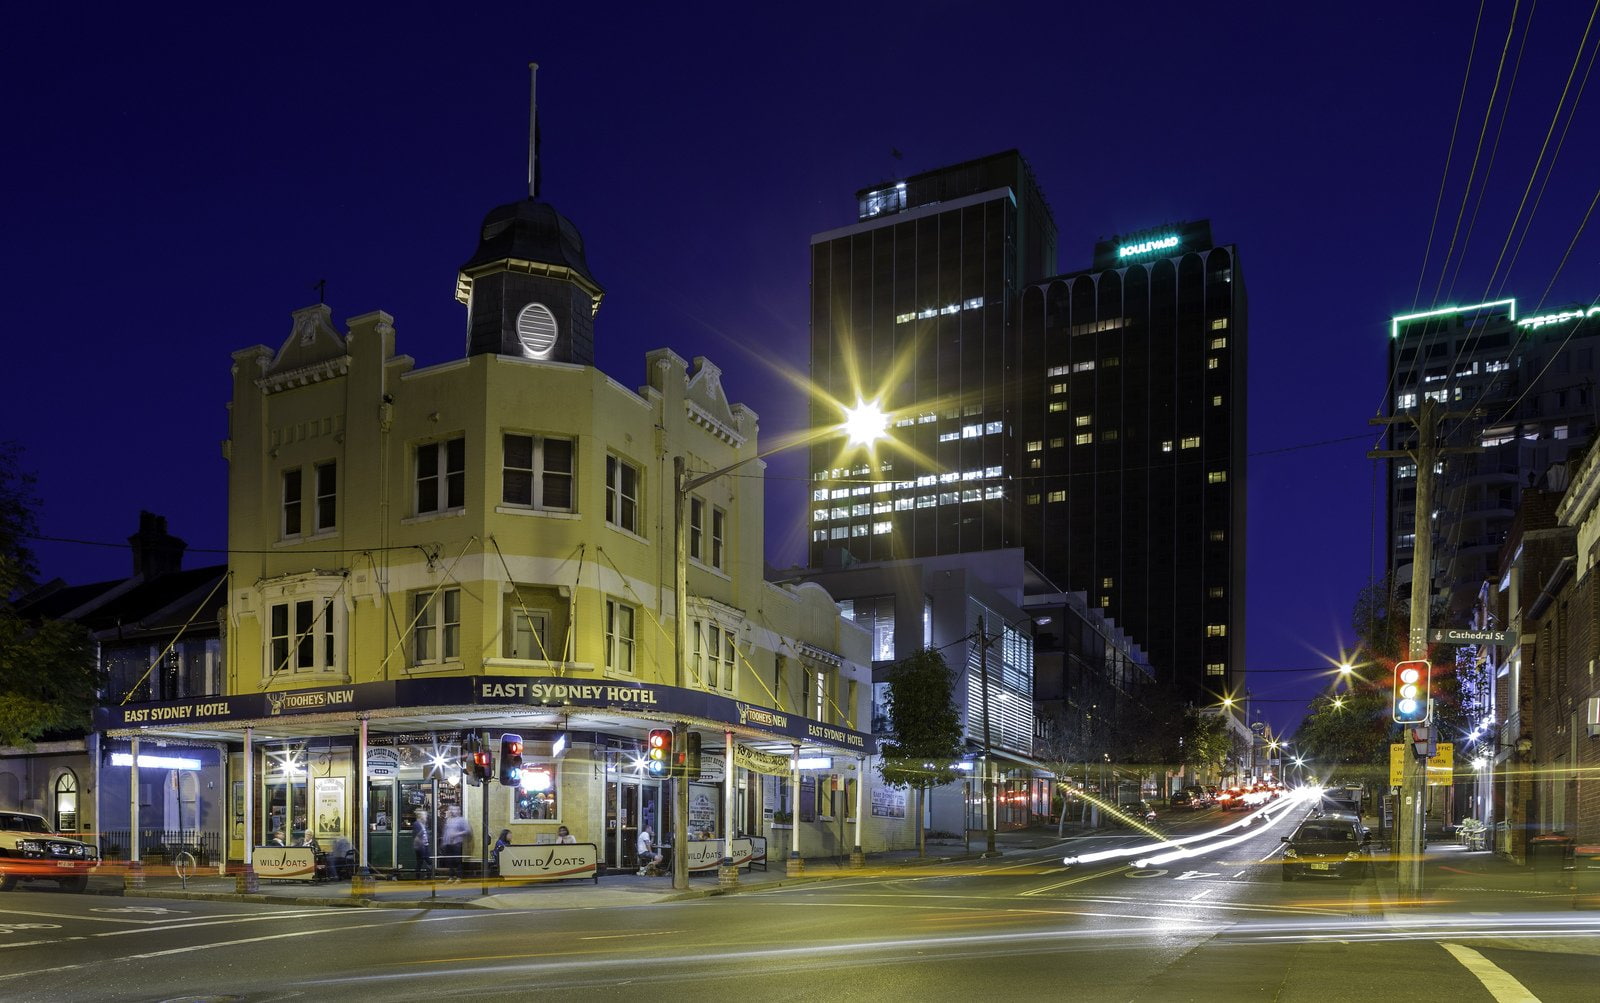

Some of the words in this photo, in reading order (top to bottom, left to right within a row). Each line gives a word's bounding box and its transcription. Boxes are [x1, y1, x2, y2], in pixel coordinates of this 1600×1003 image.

[1120, 237, 1178, 257] BOULEVARD
[1449, 631, 1493, 640] Cathedral
[1495, 633, 1504, 641] St
[286, 694, 324, 707] TOOHEYS
[327, 690, 354, 704] NEW
[482, 683, 527, 698] EAST
[532, 684, 604, 699] SYDNEY
[607, 687, 657, 704] HOTEL
[124, 709, 150, 722] EAST
[151, 705, 193, 720] SYDNEY
[195, 702, 230, 717] HOTEL
[749, 711, 772, 723] TOOHEYS
[772, 714, 787, 728] NEW
[808, 724, 823, 738] EAST
[824, 728, 846, 743] SYDNEY
[847, 734, 864, 747] HOTEL
[260, 859, 280, 867] WILD
[512, 859, 544, 867] WILD
[553, 857, 585, 866] OATS
[705, 851, 722, 859] OATS
